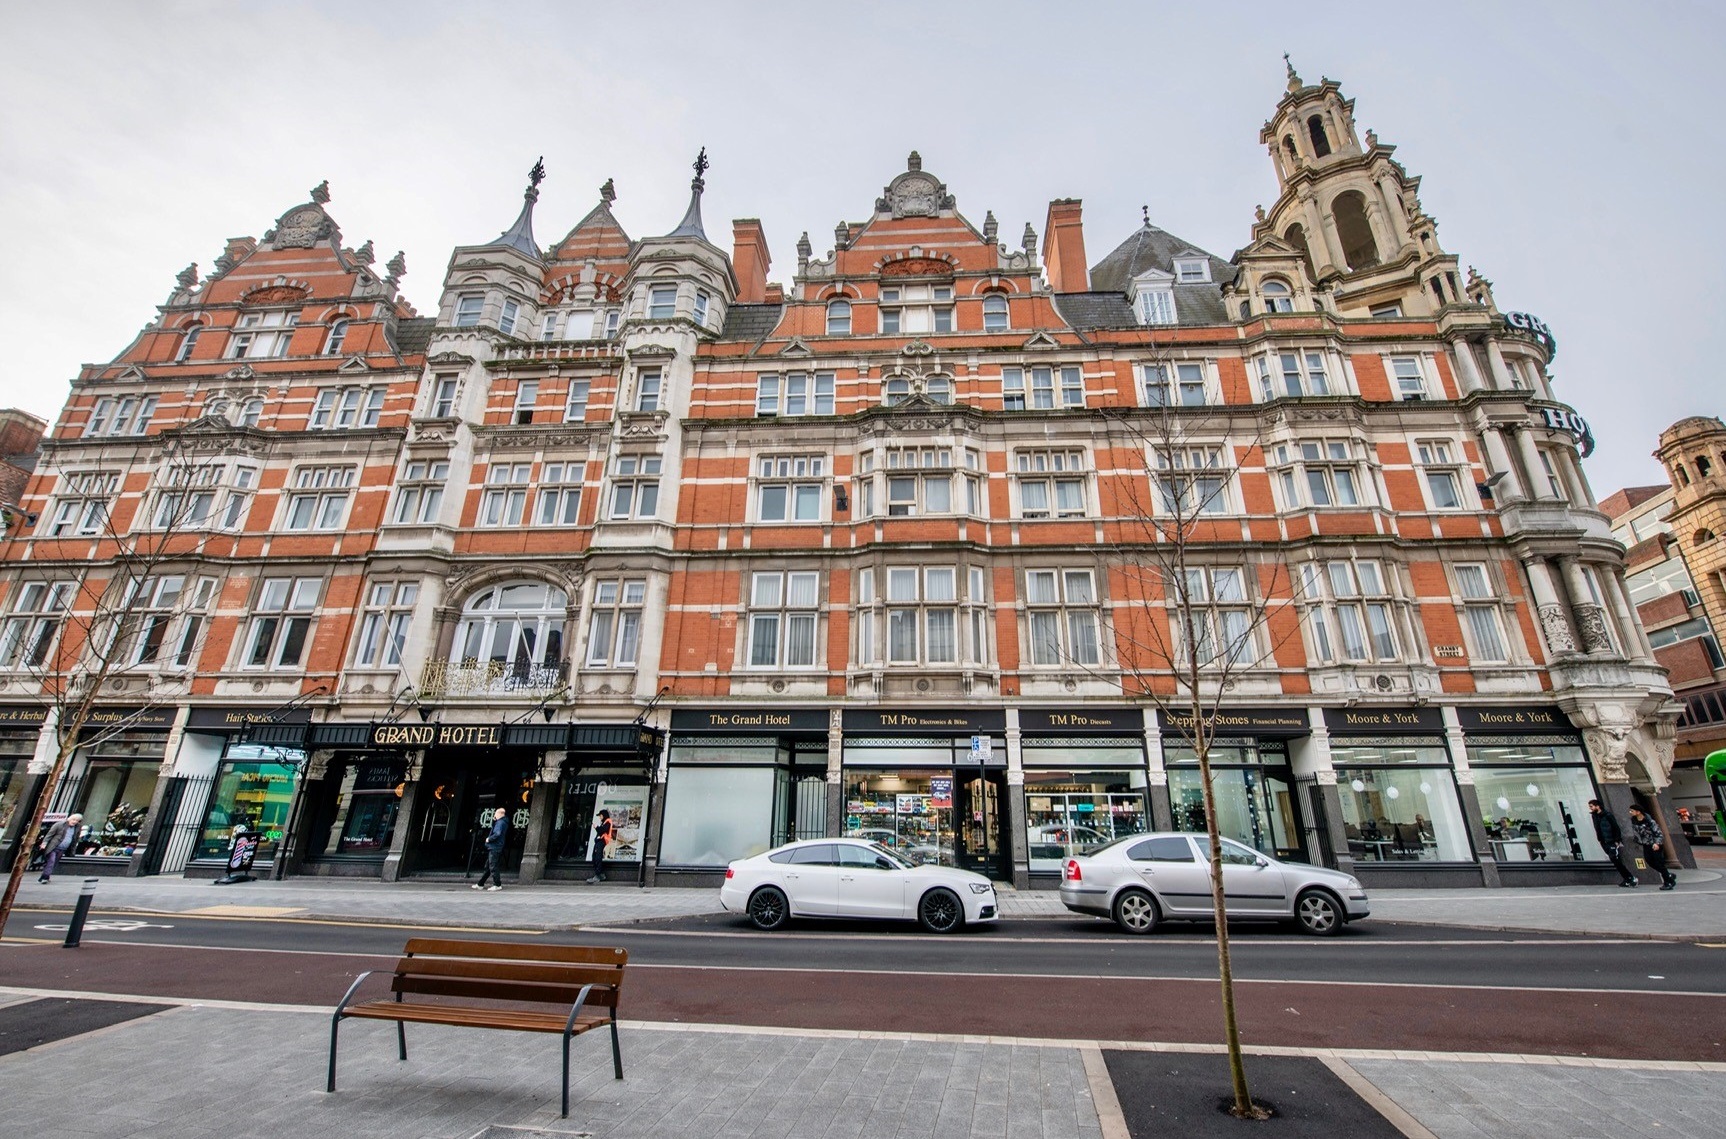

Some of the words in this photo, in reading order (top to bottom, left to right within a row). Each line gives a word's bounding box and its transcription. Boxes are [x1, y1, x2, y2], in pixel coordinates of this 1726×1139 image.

[19, 710, 46, 720] Herbal
[91, 712, 123, 722] Surplus
[225, 712, 244, 723] Hair
[709, 714, 728, 725] The
[731, 714, 762, 725] Grand
[765, 714, 790, 725] Hotel
[880, 715, 898, 725] TM
[901, 715, 917, 725] Pro
[1049, 714, 1068, 725] TM
[1070, 714, 1087, 725] Pro
[1166, 714, 1213, 727] Steppng
[1215, 714, 1249, 725] Stones
[1346, 713, 1379, 724] Moore
[1382, 713, 1391, 723] &
[1394, 713, 1420, 723] York
[1478, 712, 1513, 723] Moore
[1515, 712, 1525, 722] &
[1528, 712, 1553, 722] York
[1278, 718, 1302, 726] Planning
[374, 726, 434, 744] GRAND
[439, 727, 499, 744] HOTEL
